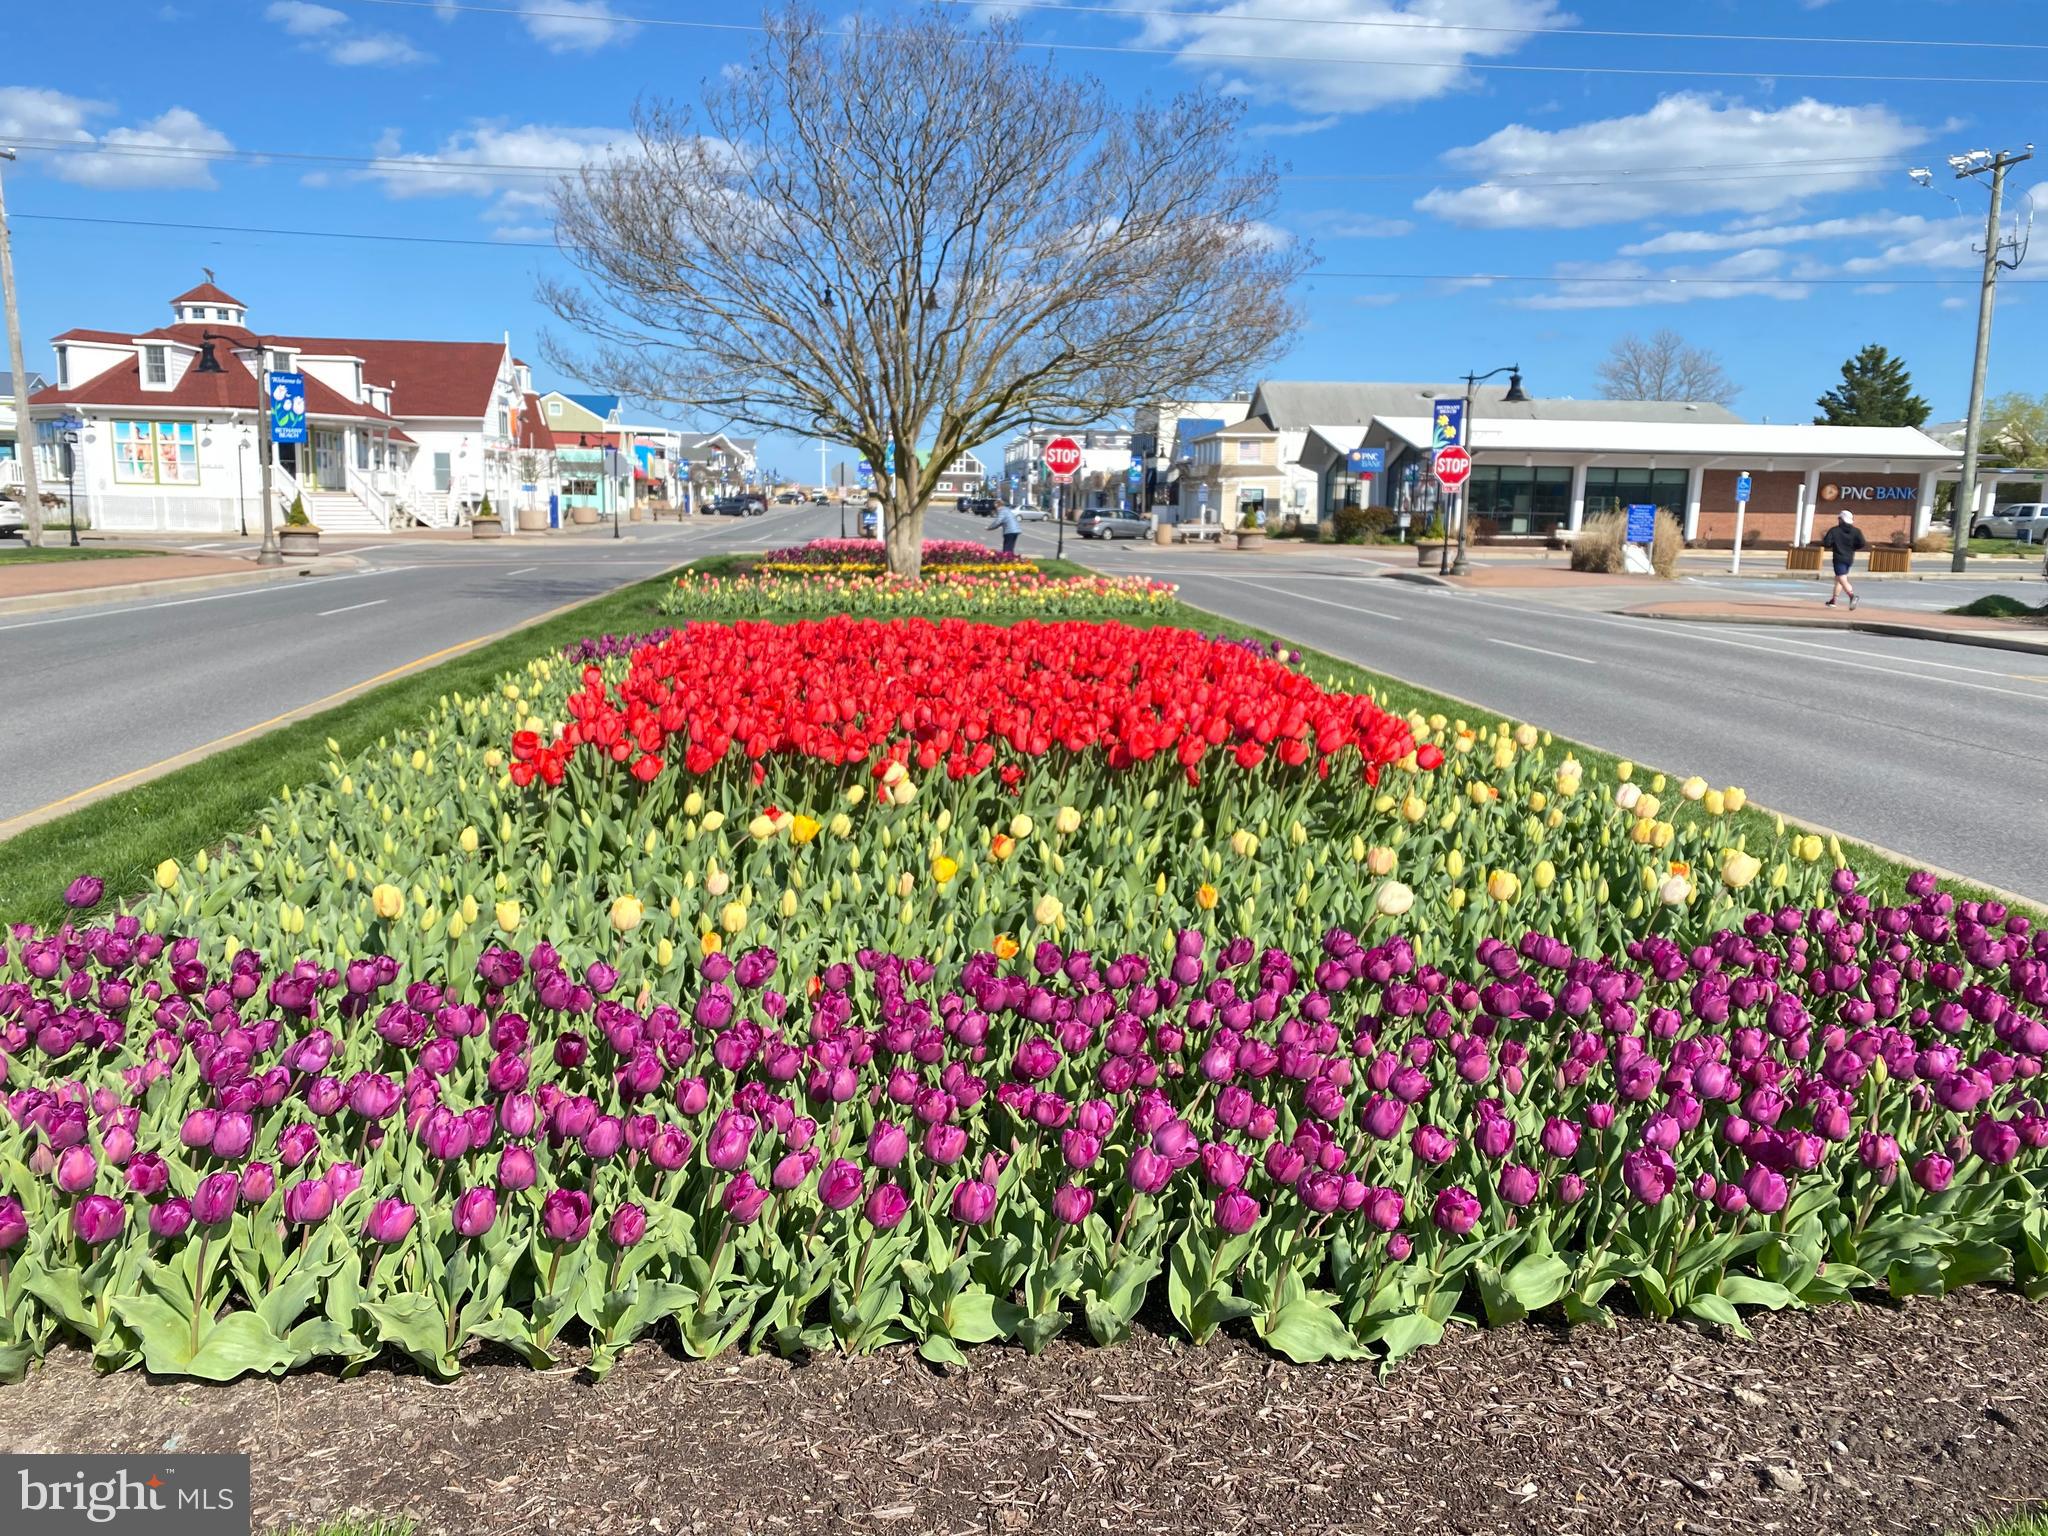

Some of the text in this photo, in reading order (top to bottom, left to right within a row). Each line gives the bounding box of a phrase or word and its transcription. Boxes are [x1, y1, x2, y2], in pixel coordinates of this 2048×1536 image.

[1048, 448, 1080, 464] STOP
[1437, 457, 1469, 474] STOP
[1840, 486, 1918, 500] PNC BANK
